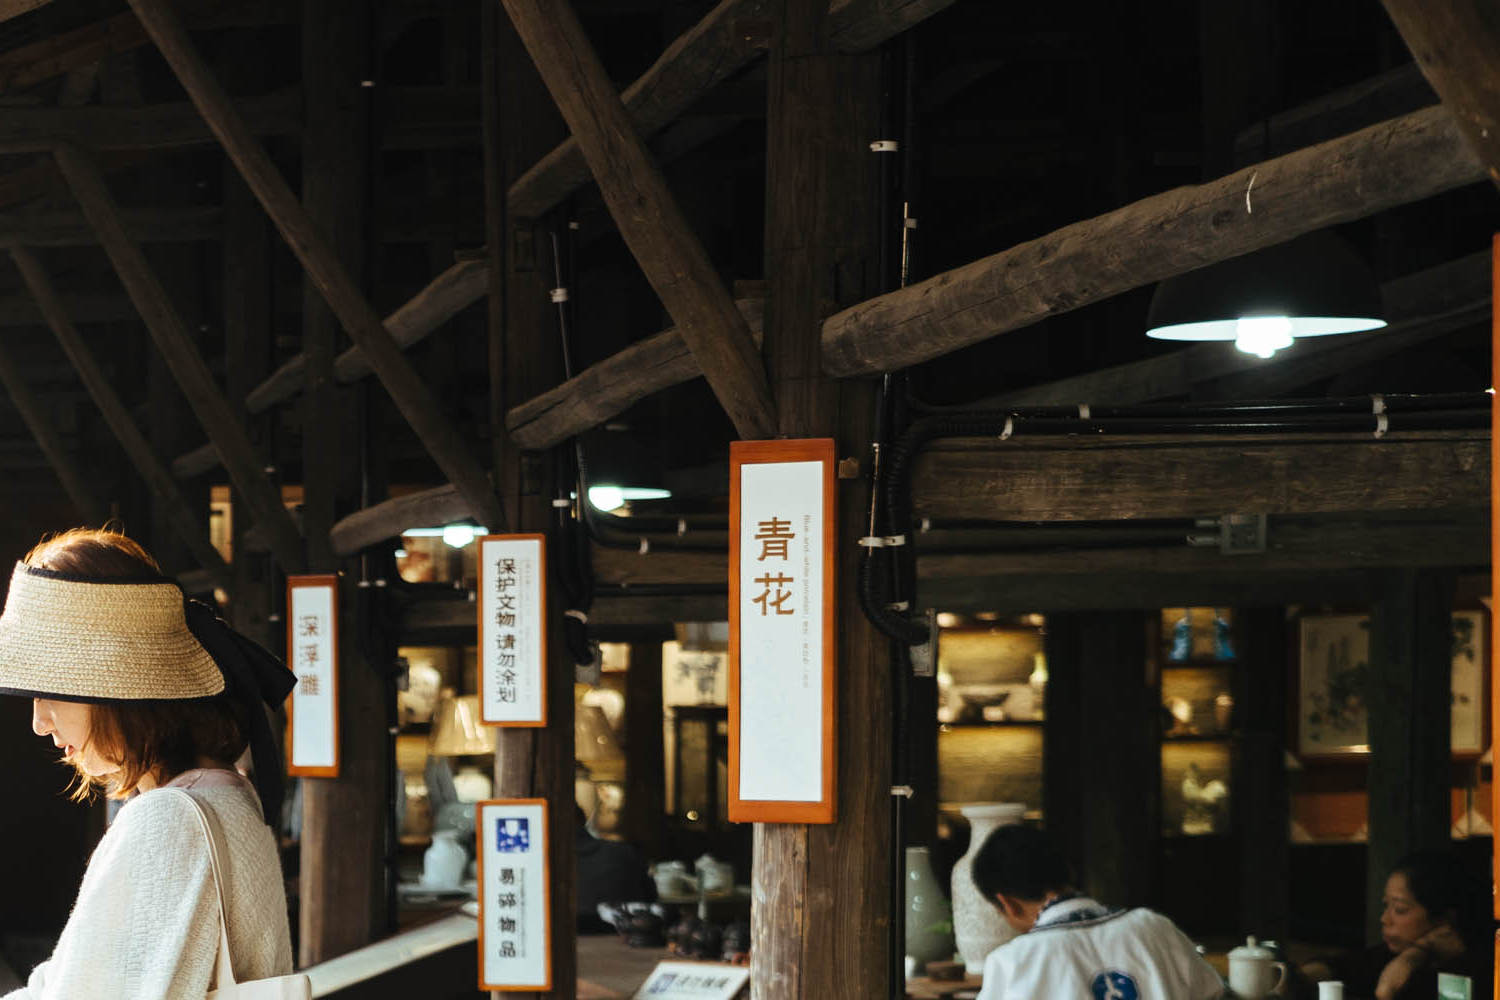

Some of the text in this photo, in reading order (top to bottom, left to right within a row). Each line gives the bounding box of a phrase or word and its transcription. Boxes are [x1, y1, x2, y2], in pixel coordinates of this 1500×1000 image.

[752, 516, 796, 616] 青花
[495, 558, 517, 704] 保护文物 请勿涂划
[498, 867, 517, 958] 易碎物品
